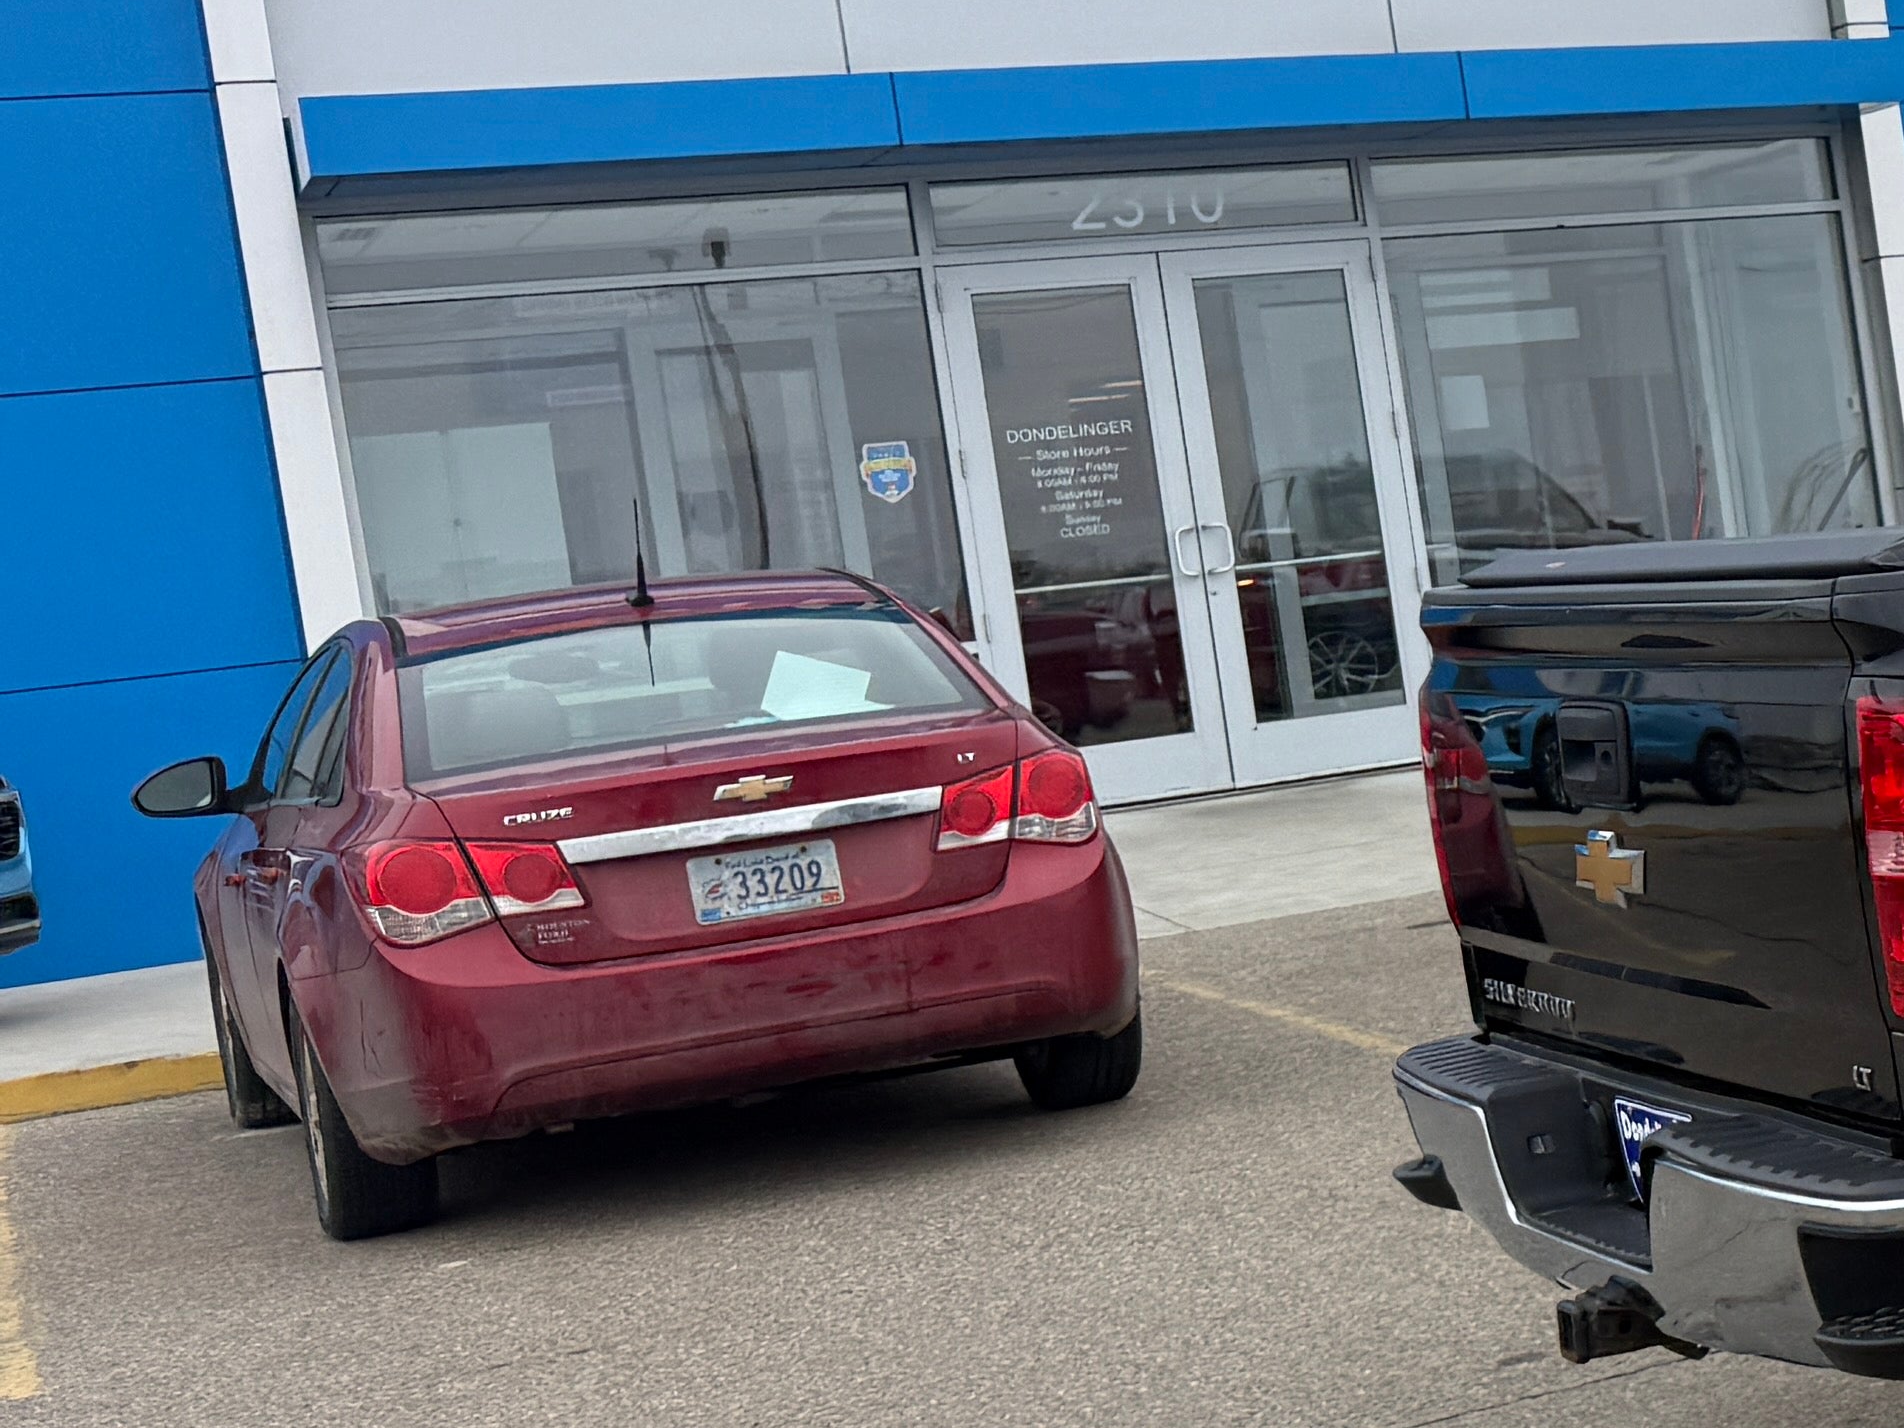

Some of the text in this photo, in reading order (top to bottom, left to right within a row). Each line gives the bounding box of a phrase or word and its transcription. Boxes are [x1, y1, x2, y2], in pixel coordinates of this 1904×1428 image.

[1006, 419, 1133, 444] DONDELINGER
[1036, 445, 1111, 461] Store Hours
[1060, 524, 1111, 538] CLOSED
[504, 807, 573, 825] CRUZE
[732, 859, 823, 900] 33209
[1853, 1065, 1871, 1091] LT
